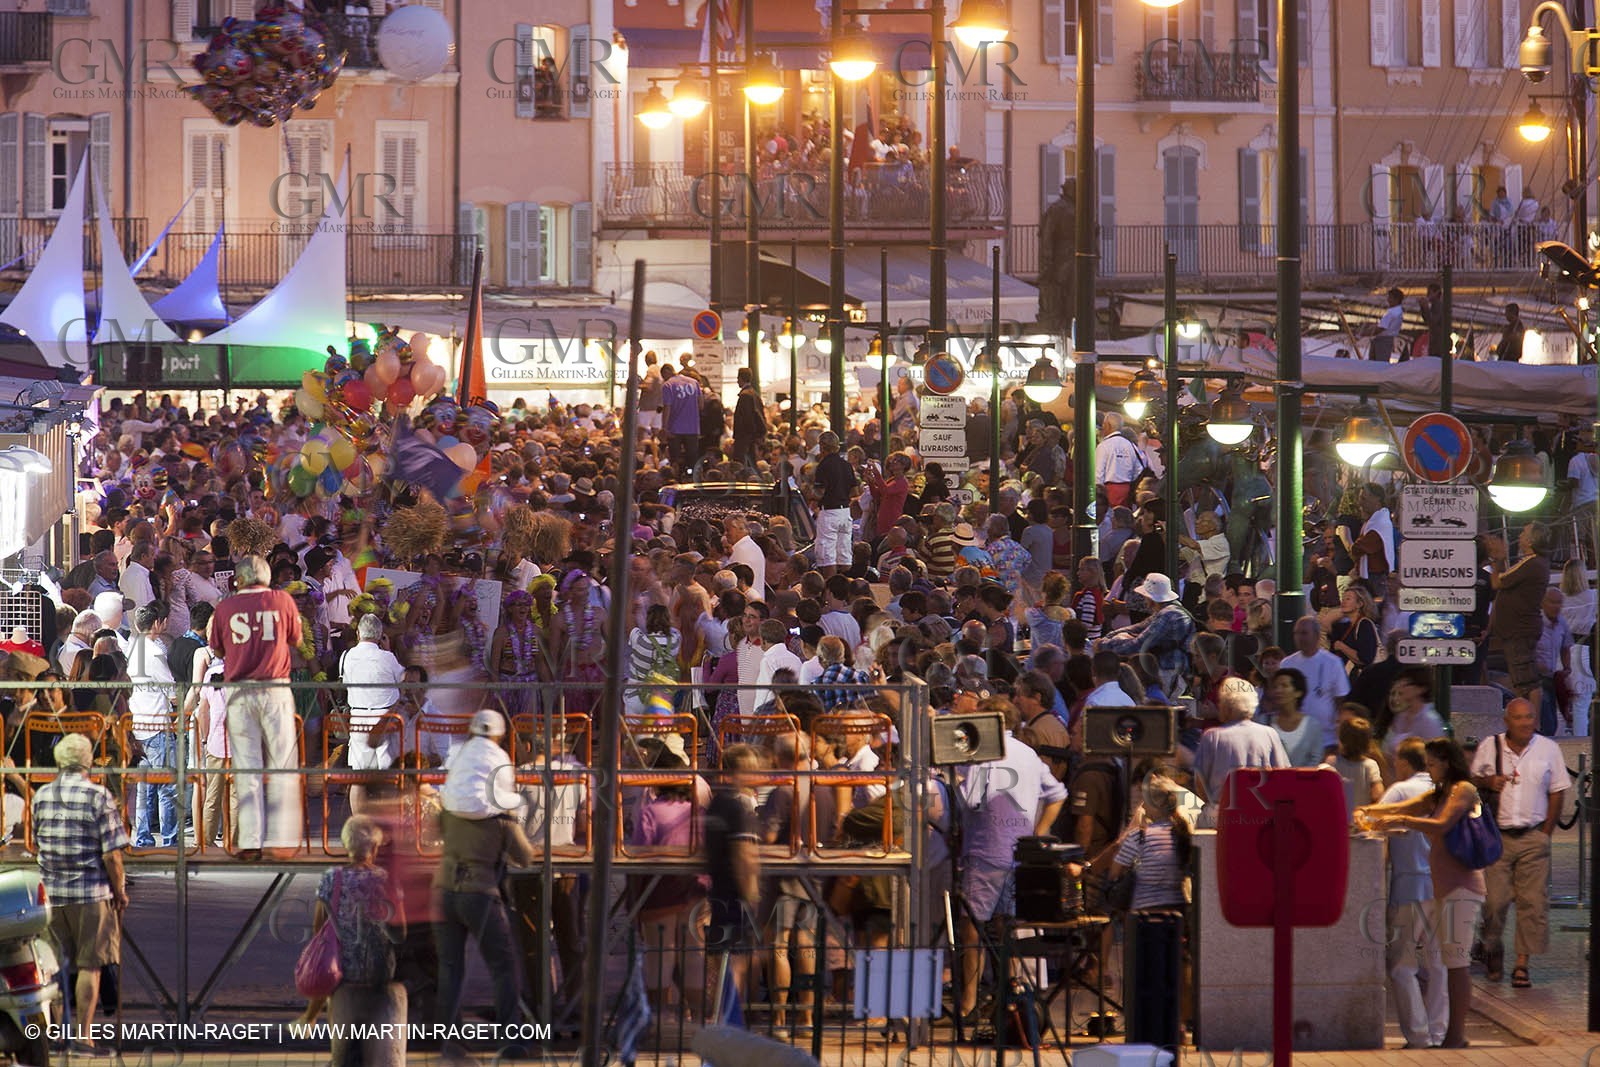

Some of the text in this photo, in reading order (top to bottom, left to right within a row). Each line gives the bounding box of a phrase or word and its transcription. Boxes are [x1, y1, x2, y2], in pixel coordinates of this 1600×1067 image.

[170, 353, 200, 373] port
[676, 384, 695, 399] 30
[932, 433, 953, 441] SAUF
[920, 444, 964, 453] LIVRAISONS
[1404, 487, 1475, 495] STATIONNEMENT
[1423, 548, 1455, 560] SAUF
[215, 571, 233, 579] CREW
[1403, 567, 1474, 578] LIVRAISONS
[229, 610, 280, 645] S-T
[1400, 645, 1417, 657] DE
